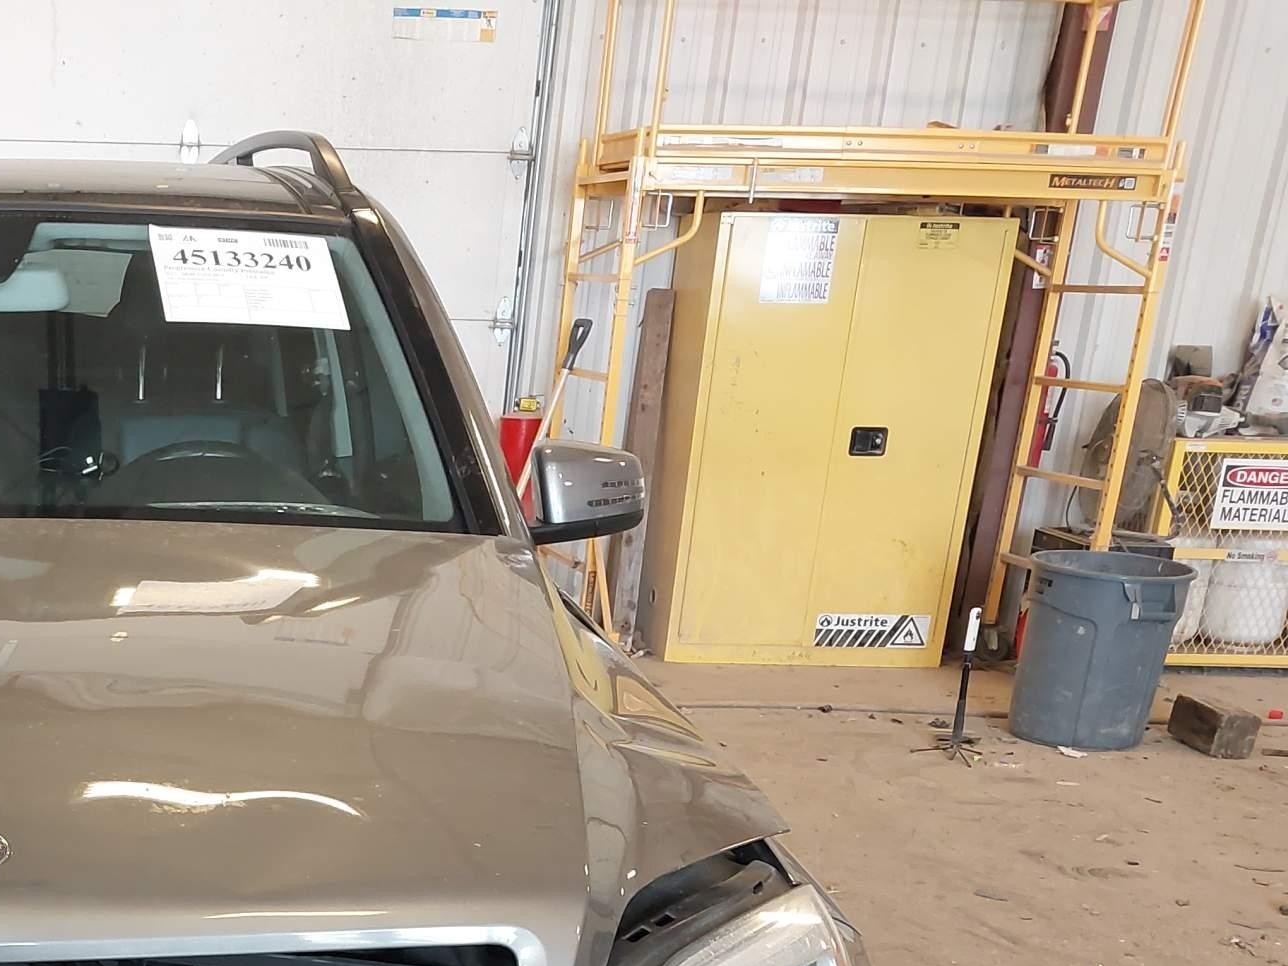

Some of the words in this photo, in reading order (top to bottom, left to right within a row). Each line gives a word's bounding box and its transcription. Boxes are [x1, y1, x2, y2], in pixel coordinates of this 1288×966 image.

[1052, 176, 1115, 188] METALTECH
[173, 248, 312, 273] 45133240
[1237, 552, 1265, 561] Smoking
[834, 616, 888, 627] Justrite
